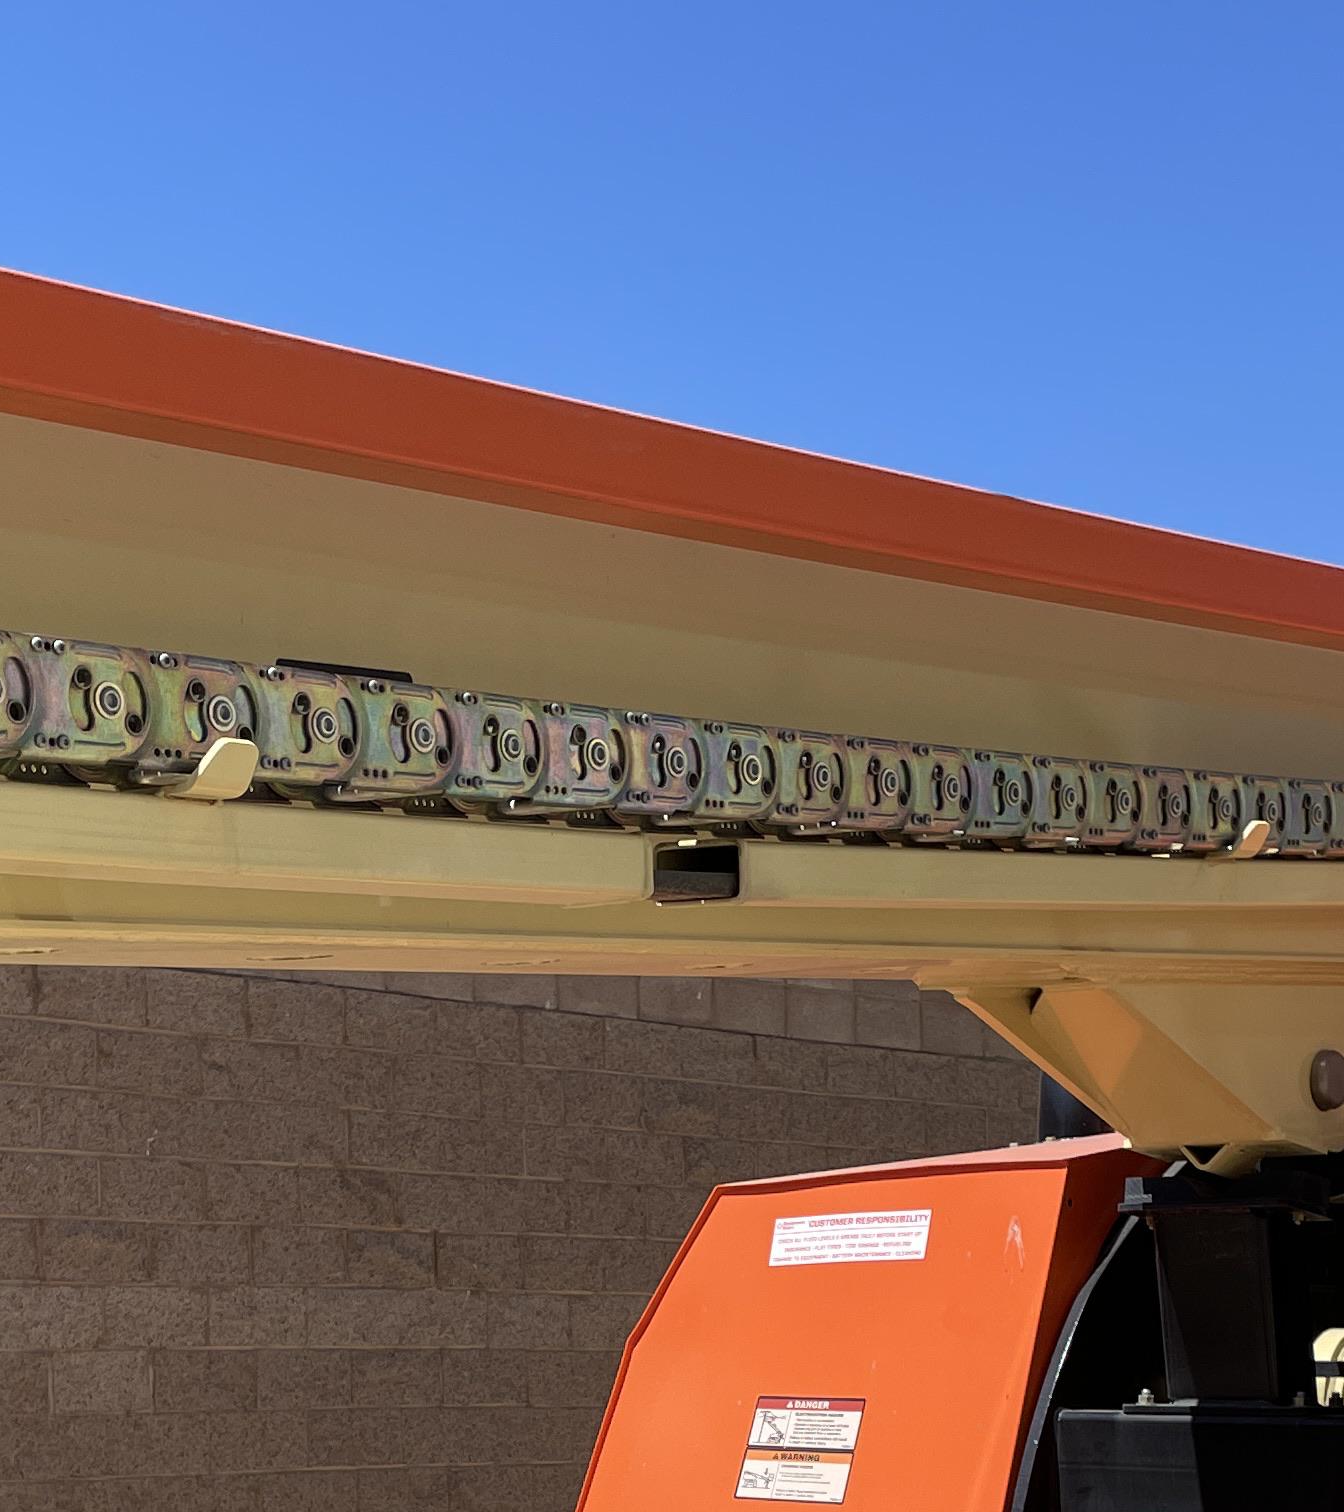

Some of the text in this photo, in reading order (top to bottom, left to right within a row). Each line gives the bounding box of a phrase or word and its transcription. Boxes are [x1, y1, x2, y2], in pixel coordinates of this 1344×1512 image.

[808, 1217, 854, 1228] CUSTOMER
[855, 1214, 929, 1225] RESPONSIBILITY
[794, 1401, 830, 1409] DANGER
[780, 1453, 820, 1462] WARNING
